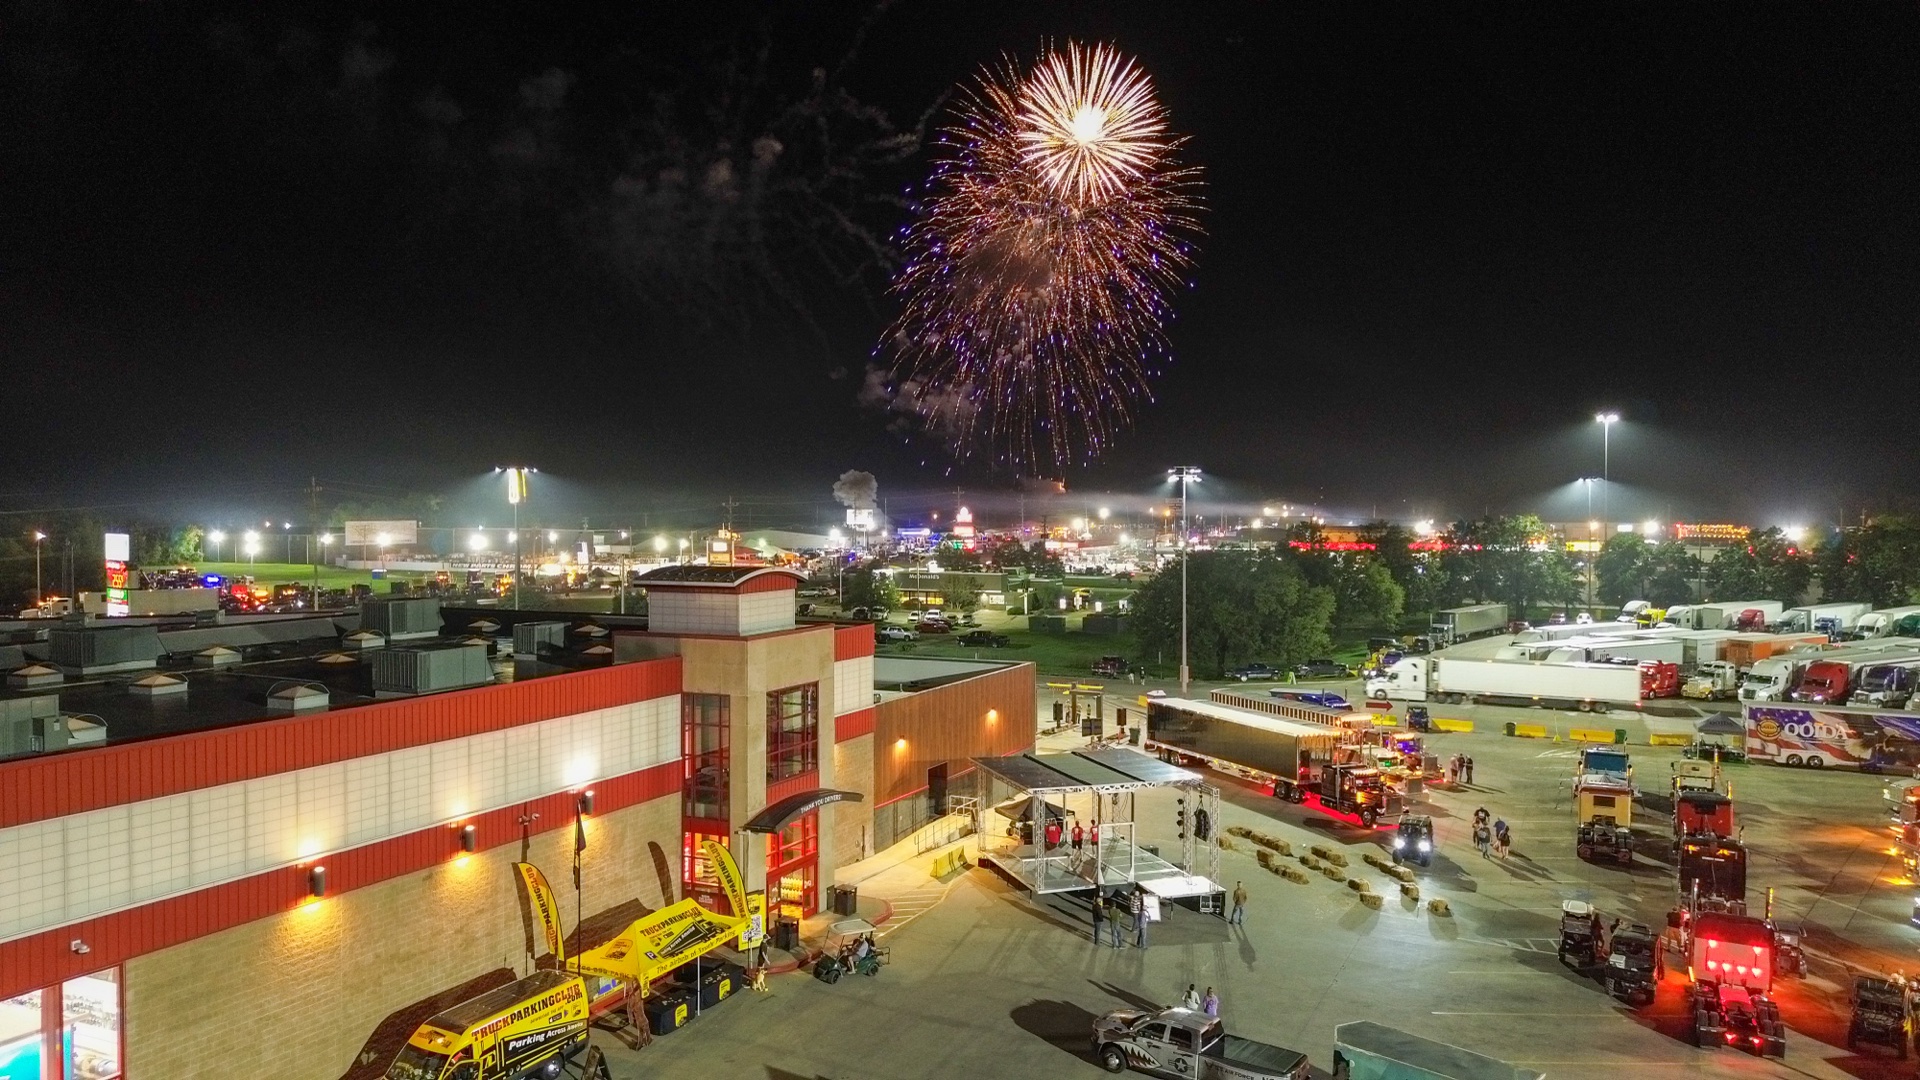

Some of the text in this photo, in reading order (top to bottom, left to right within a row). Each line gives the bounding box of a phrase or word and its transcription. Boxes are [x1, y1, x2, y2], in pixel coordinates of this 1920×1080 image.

[1784, 722, 1848, 740] OOIDA
[801, 802, 815, 814] THANK
[815, 798, 825, 806] YOU
[525, 866, 558, 948] RUCKPARKINGCLUB
[639, 906, 701, 937] TRUCKPARKINGCLUB
[656, 963, 667, 974] The
[690, 949, 698, 958] of
[715, 930, 736, 944] Parking
[576, 965, 630, 980] 66-899-PARK
[472, 983, 582, 1042] TRUCKPARKINGCLUB
[508, 1021, 584, 1051] Parking Across America
[1234, 1071, 1255, 1080] FORCE
